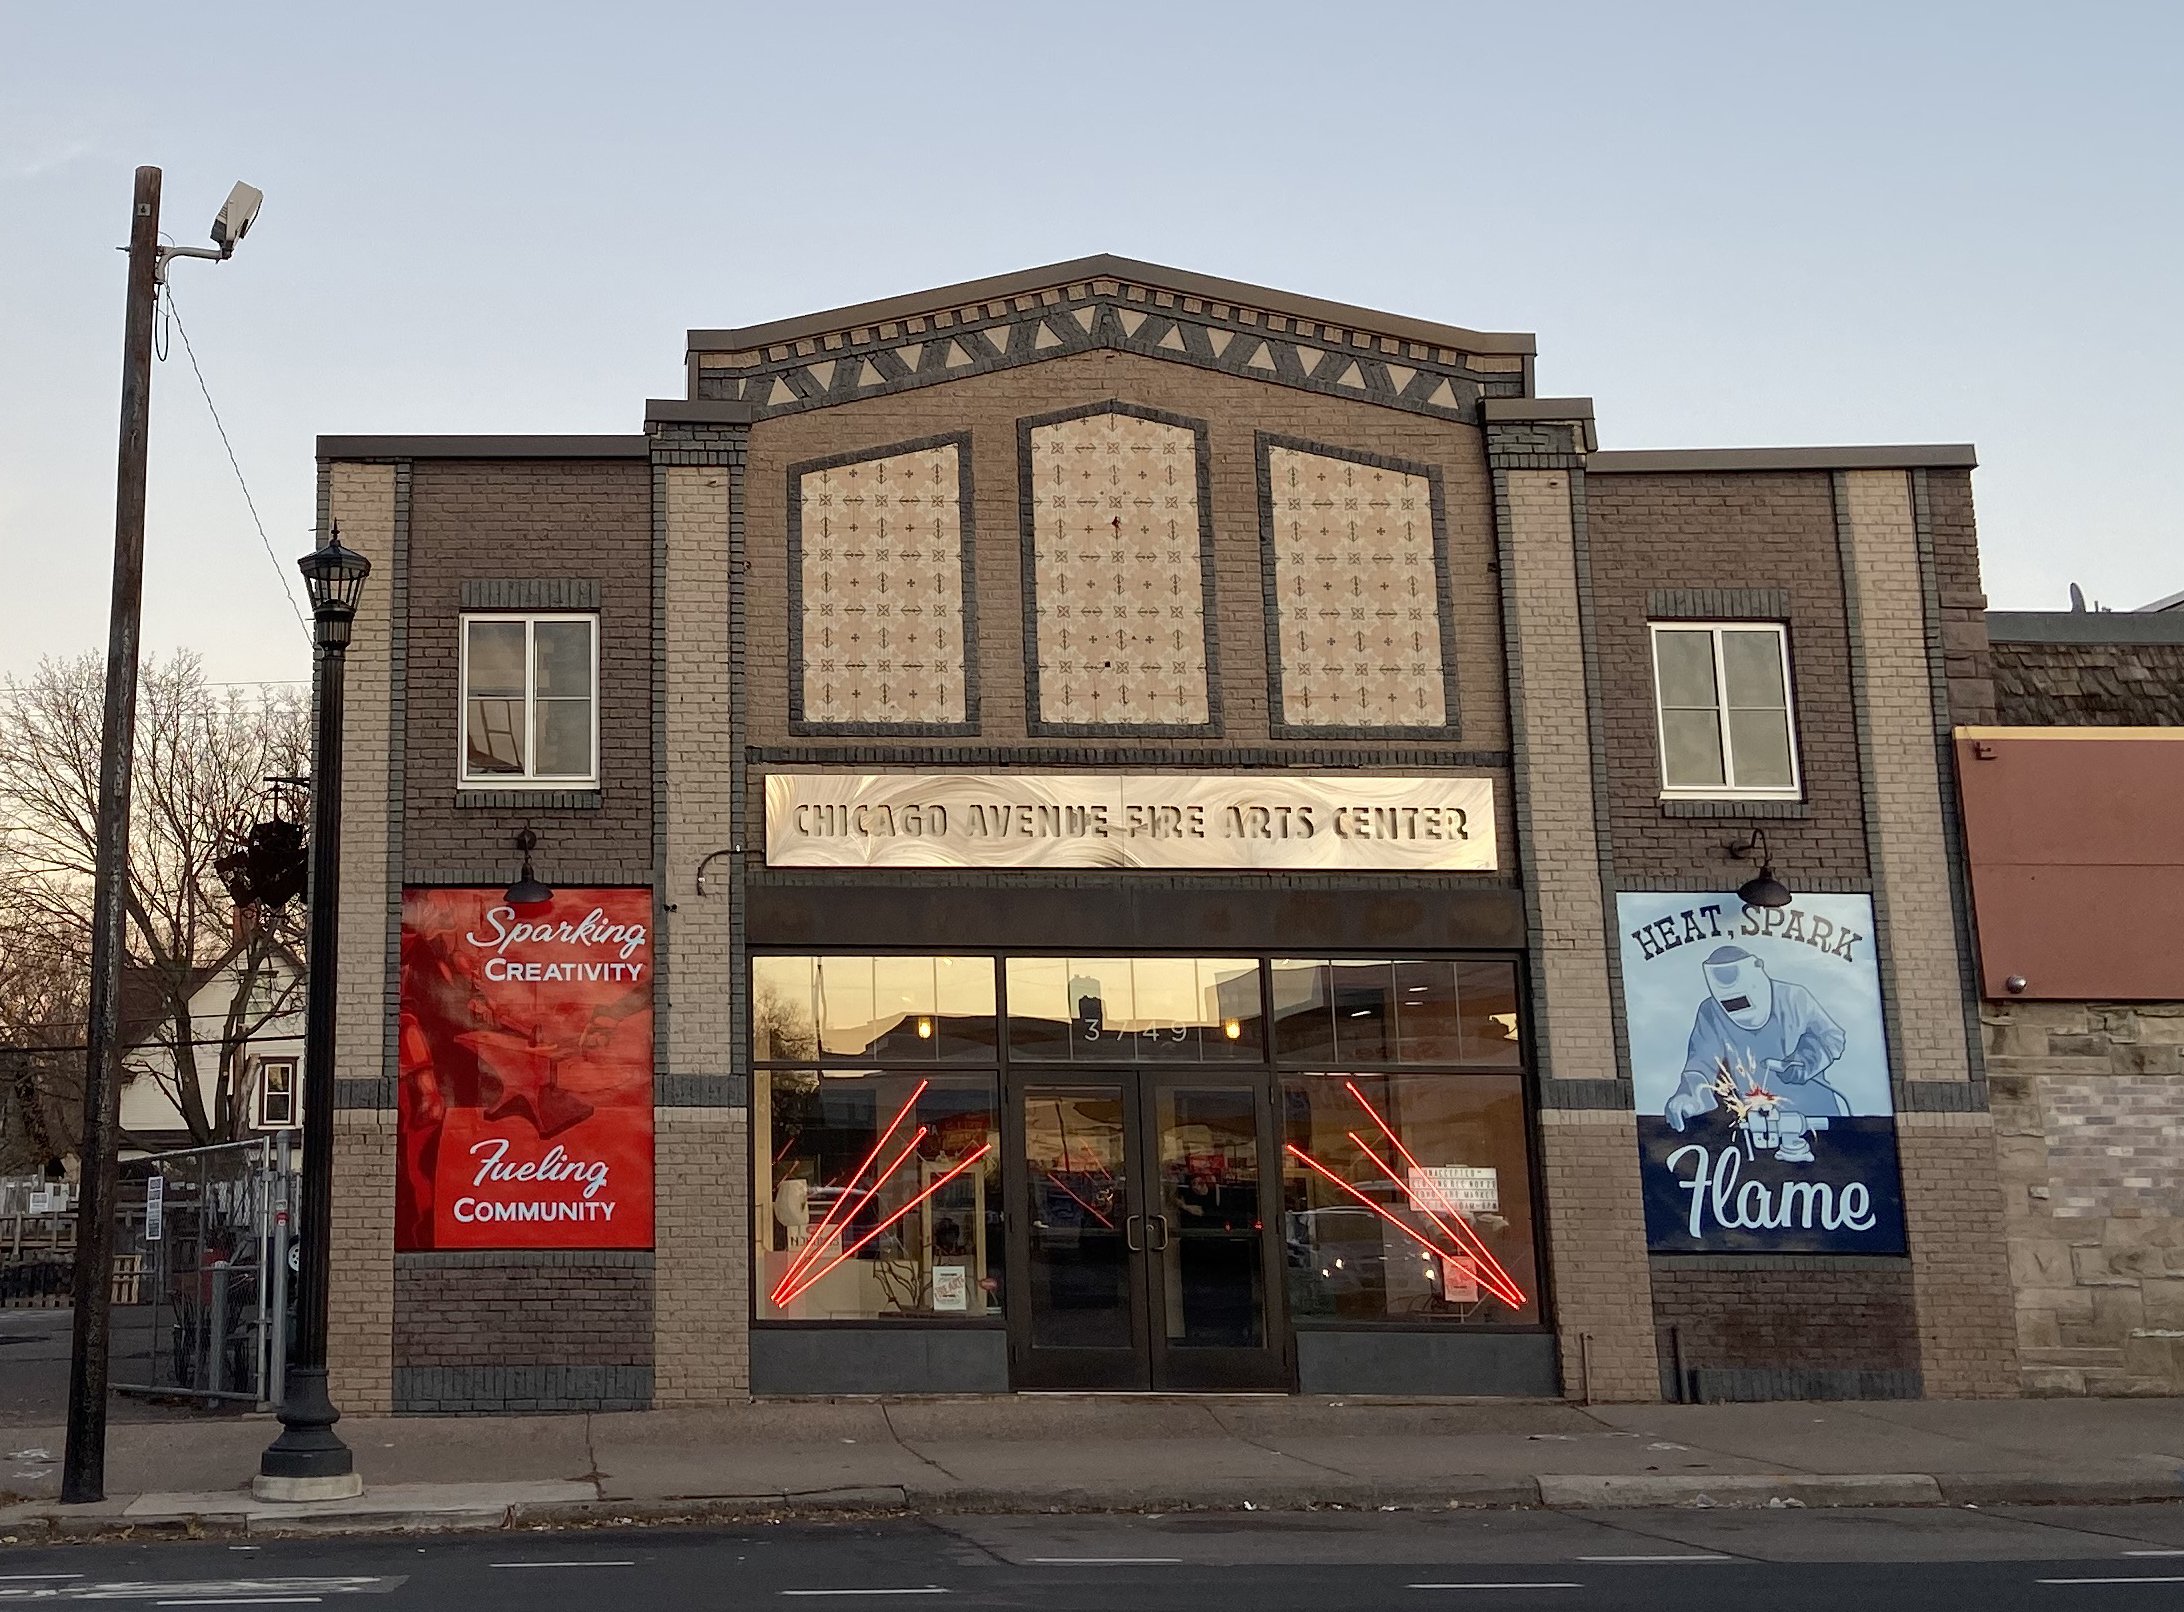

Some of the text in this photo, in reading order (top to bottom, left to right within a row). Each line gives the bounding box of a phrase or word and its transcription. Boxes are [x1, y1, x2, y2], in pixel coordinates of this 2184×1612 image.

[792, 804, 1469, 841] CHICAGO AVENUE FIRE ARTS CENTER
[466, 906, 647, 959] Sparking
[1631, 902, 1863, 962] HEAT, SPARK
[484, 957, 644, 982] CREATIVITY
[469, 1138, 611, 1198] Fueling
[1665, 1144, 1877, 1239] Flame
[453, 1197, 616, 1223] COMMUNITY
